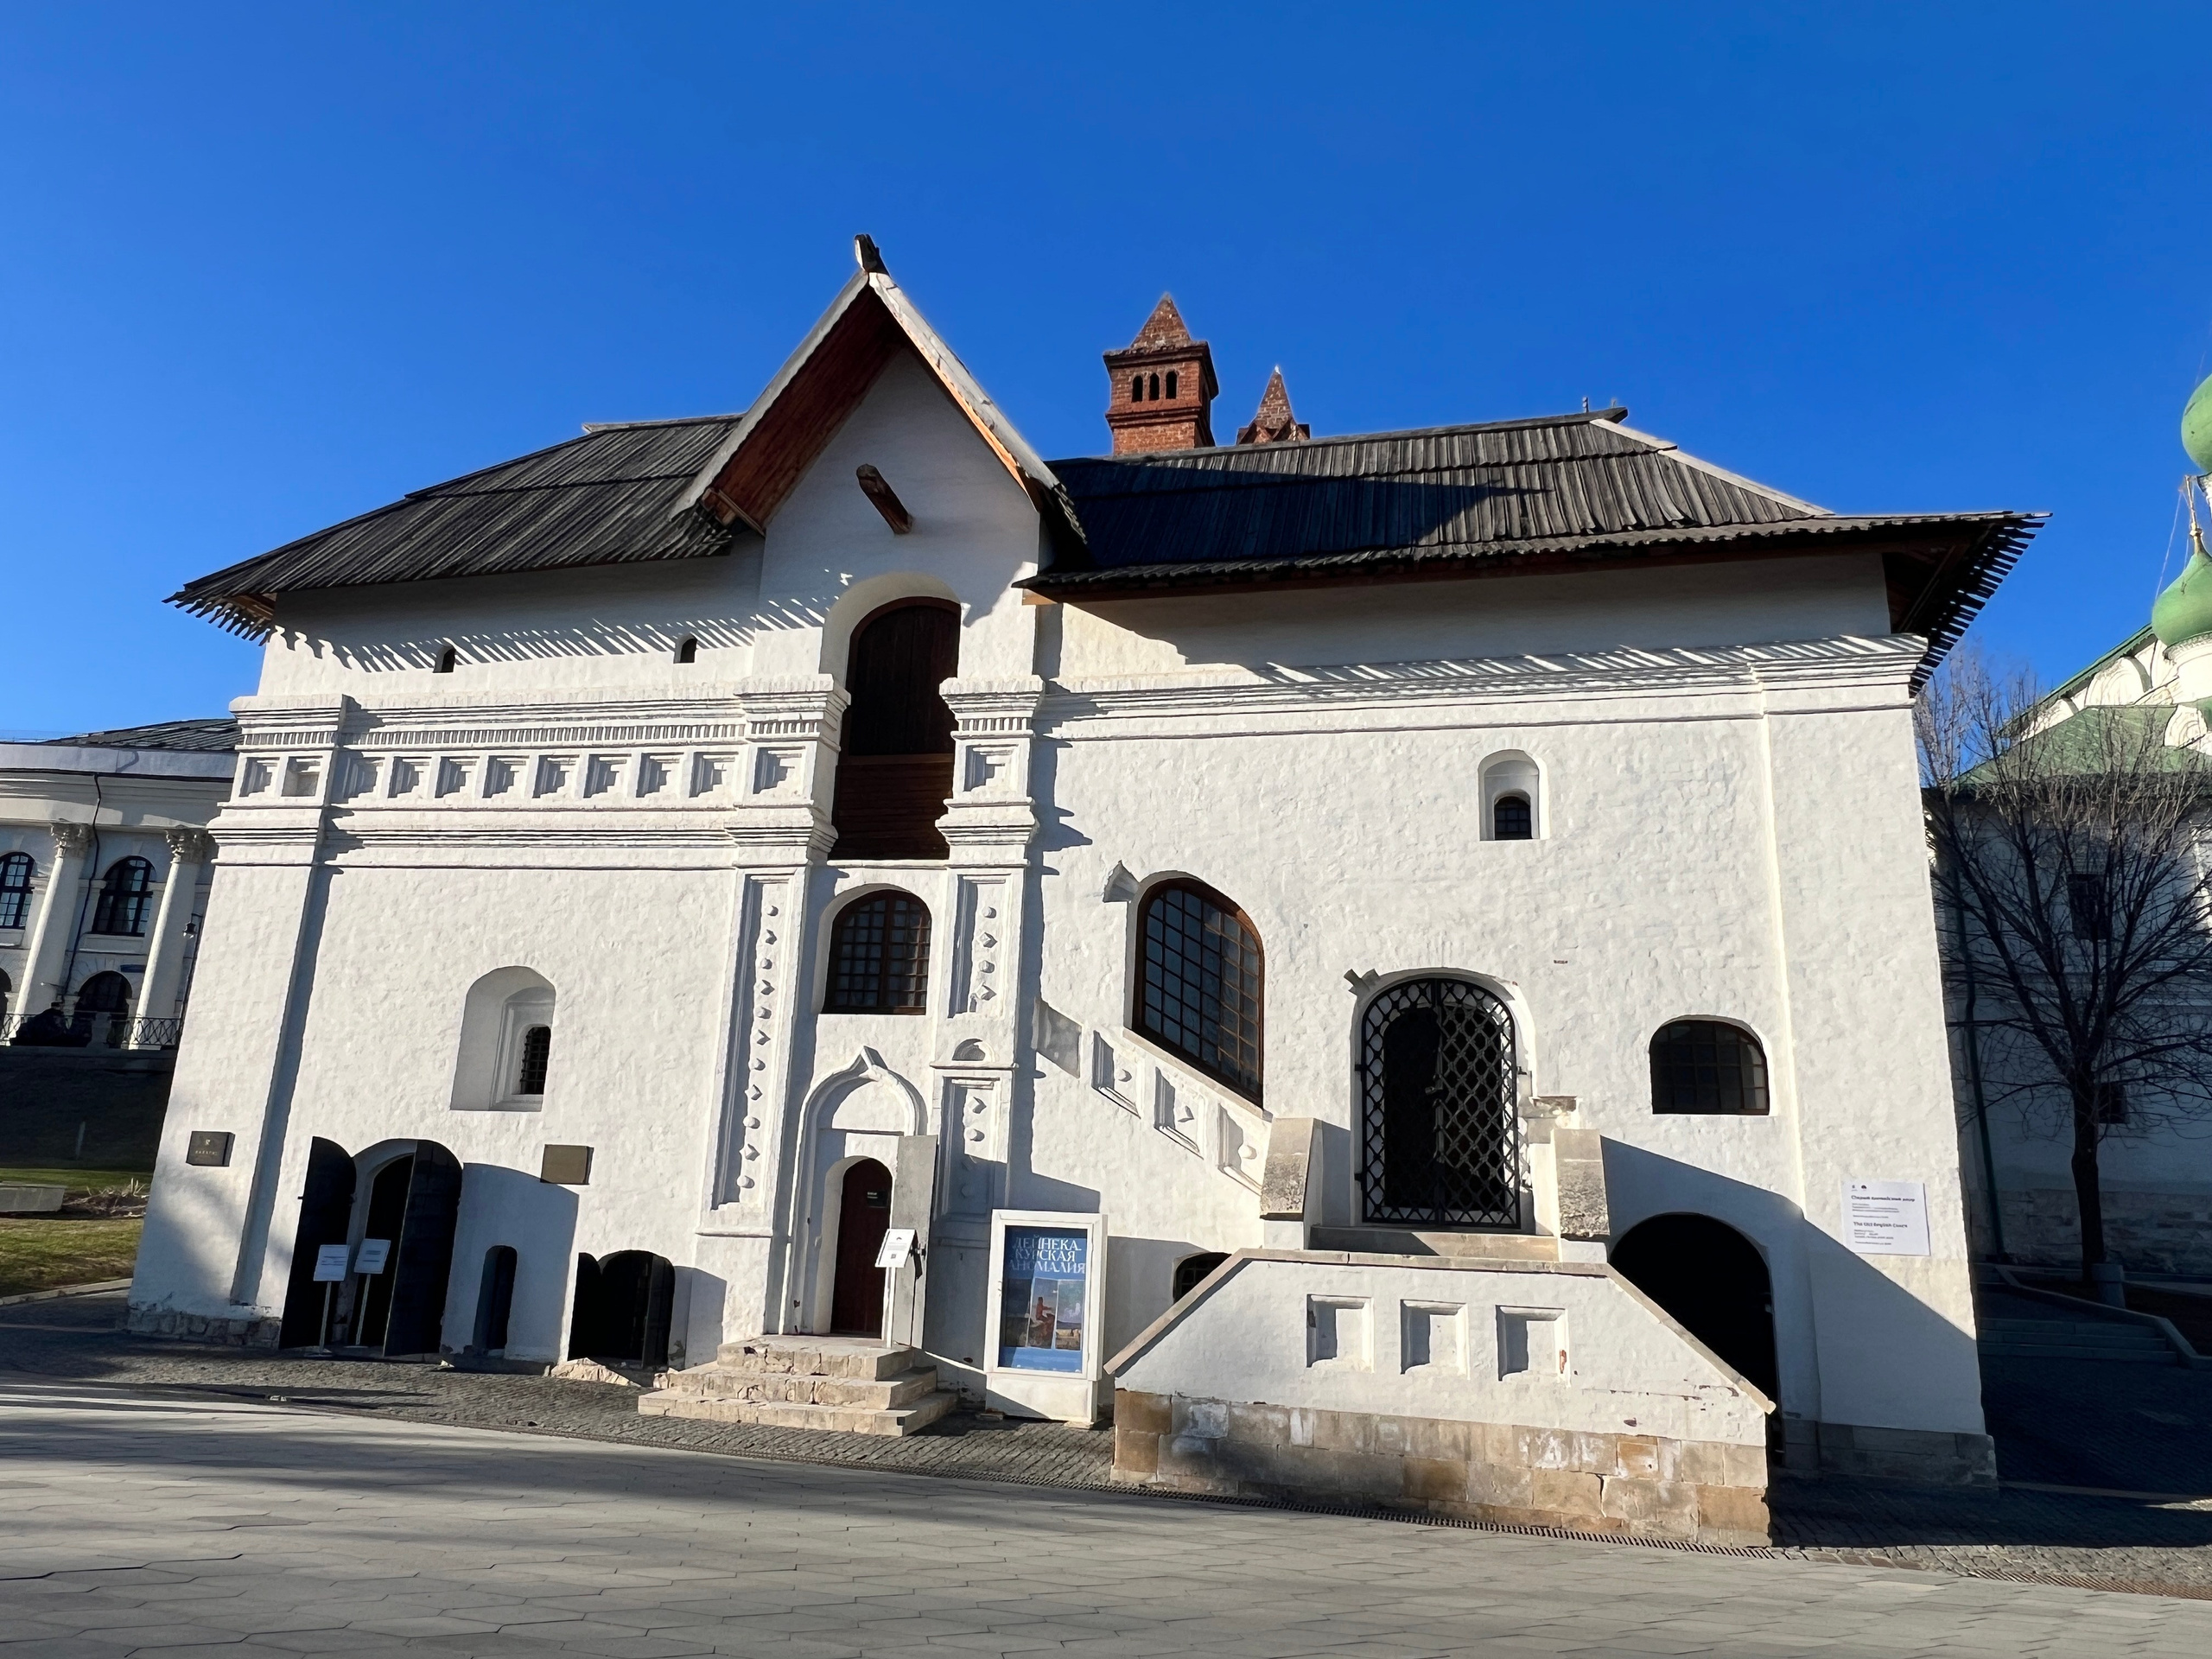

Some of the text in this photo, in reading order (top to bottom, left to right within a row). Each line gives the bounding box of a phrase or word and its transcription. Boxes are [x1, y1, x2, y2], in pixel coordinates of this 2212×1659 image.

[1012, 1234, 1082, 1251] ДЕЙНЕКА
[1014, 1249, 1076, 1262] КУРСКАЯ
[1009, 1260, 1086, 1274] АНОМАЛИЯ
